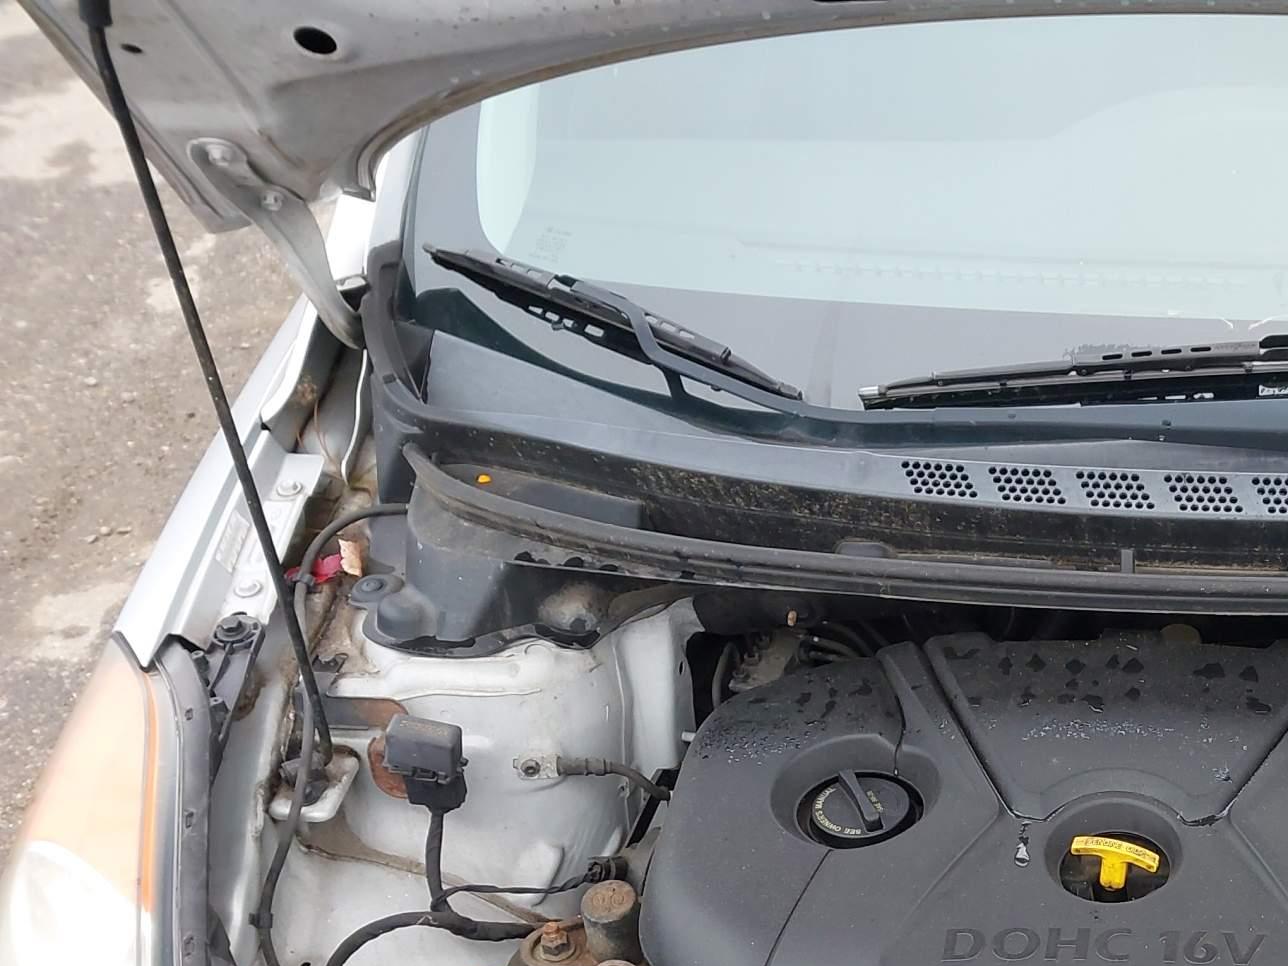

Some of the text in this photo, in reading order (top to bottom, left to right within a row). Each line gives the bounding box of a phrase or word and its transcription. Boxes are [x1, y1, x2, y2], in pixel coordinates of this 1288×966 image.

[815, 787, 861, 835] SEE OWNER'S MANUAL
[941, 927, 1266, 966] DOHC 16V
